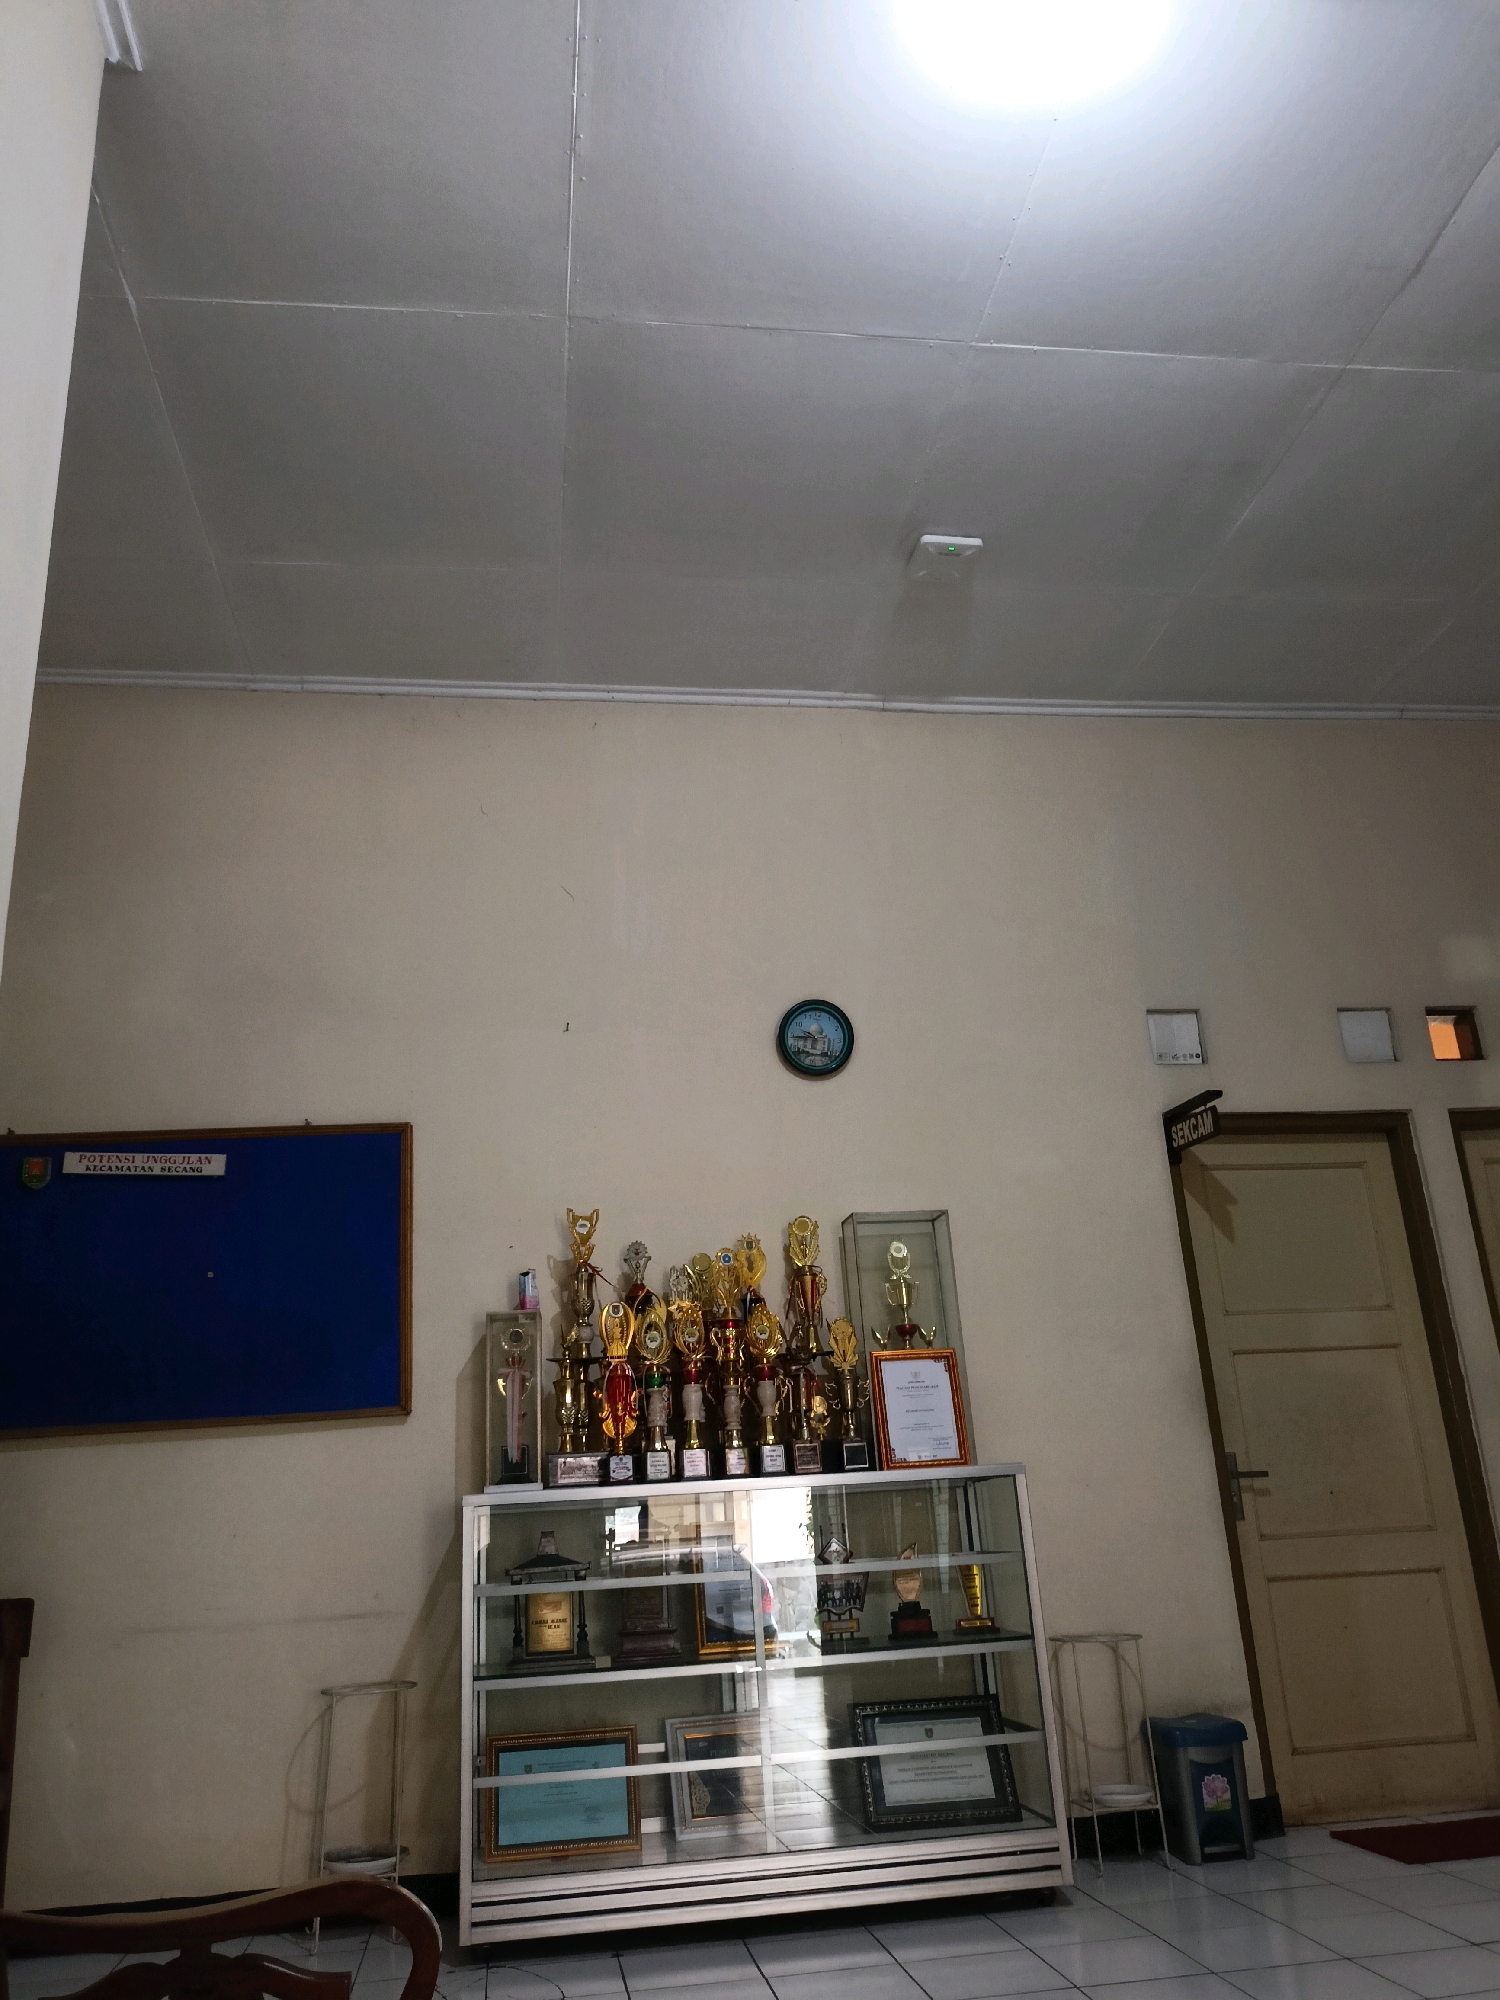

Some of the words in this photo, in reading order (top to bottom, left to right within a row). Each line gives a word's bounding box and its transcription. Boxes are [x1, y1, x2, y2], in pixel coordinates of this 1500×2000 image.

[1171, 1110, 1214, 1148] SEKCAM
[78, 1154, 136, 1164] POTENSI
[142, 1155, 213, 1165] UNGGULAN
[85, 1164, 155, 1173] KECAMATAN
[160, 1165, 203, 1174] SECANG
